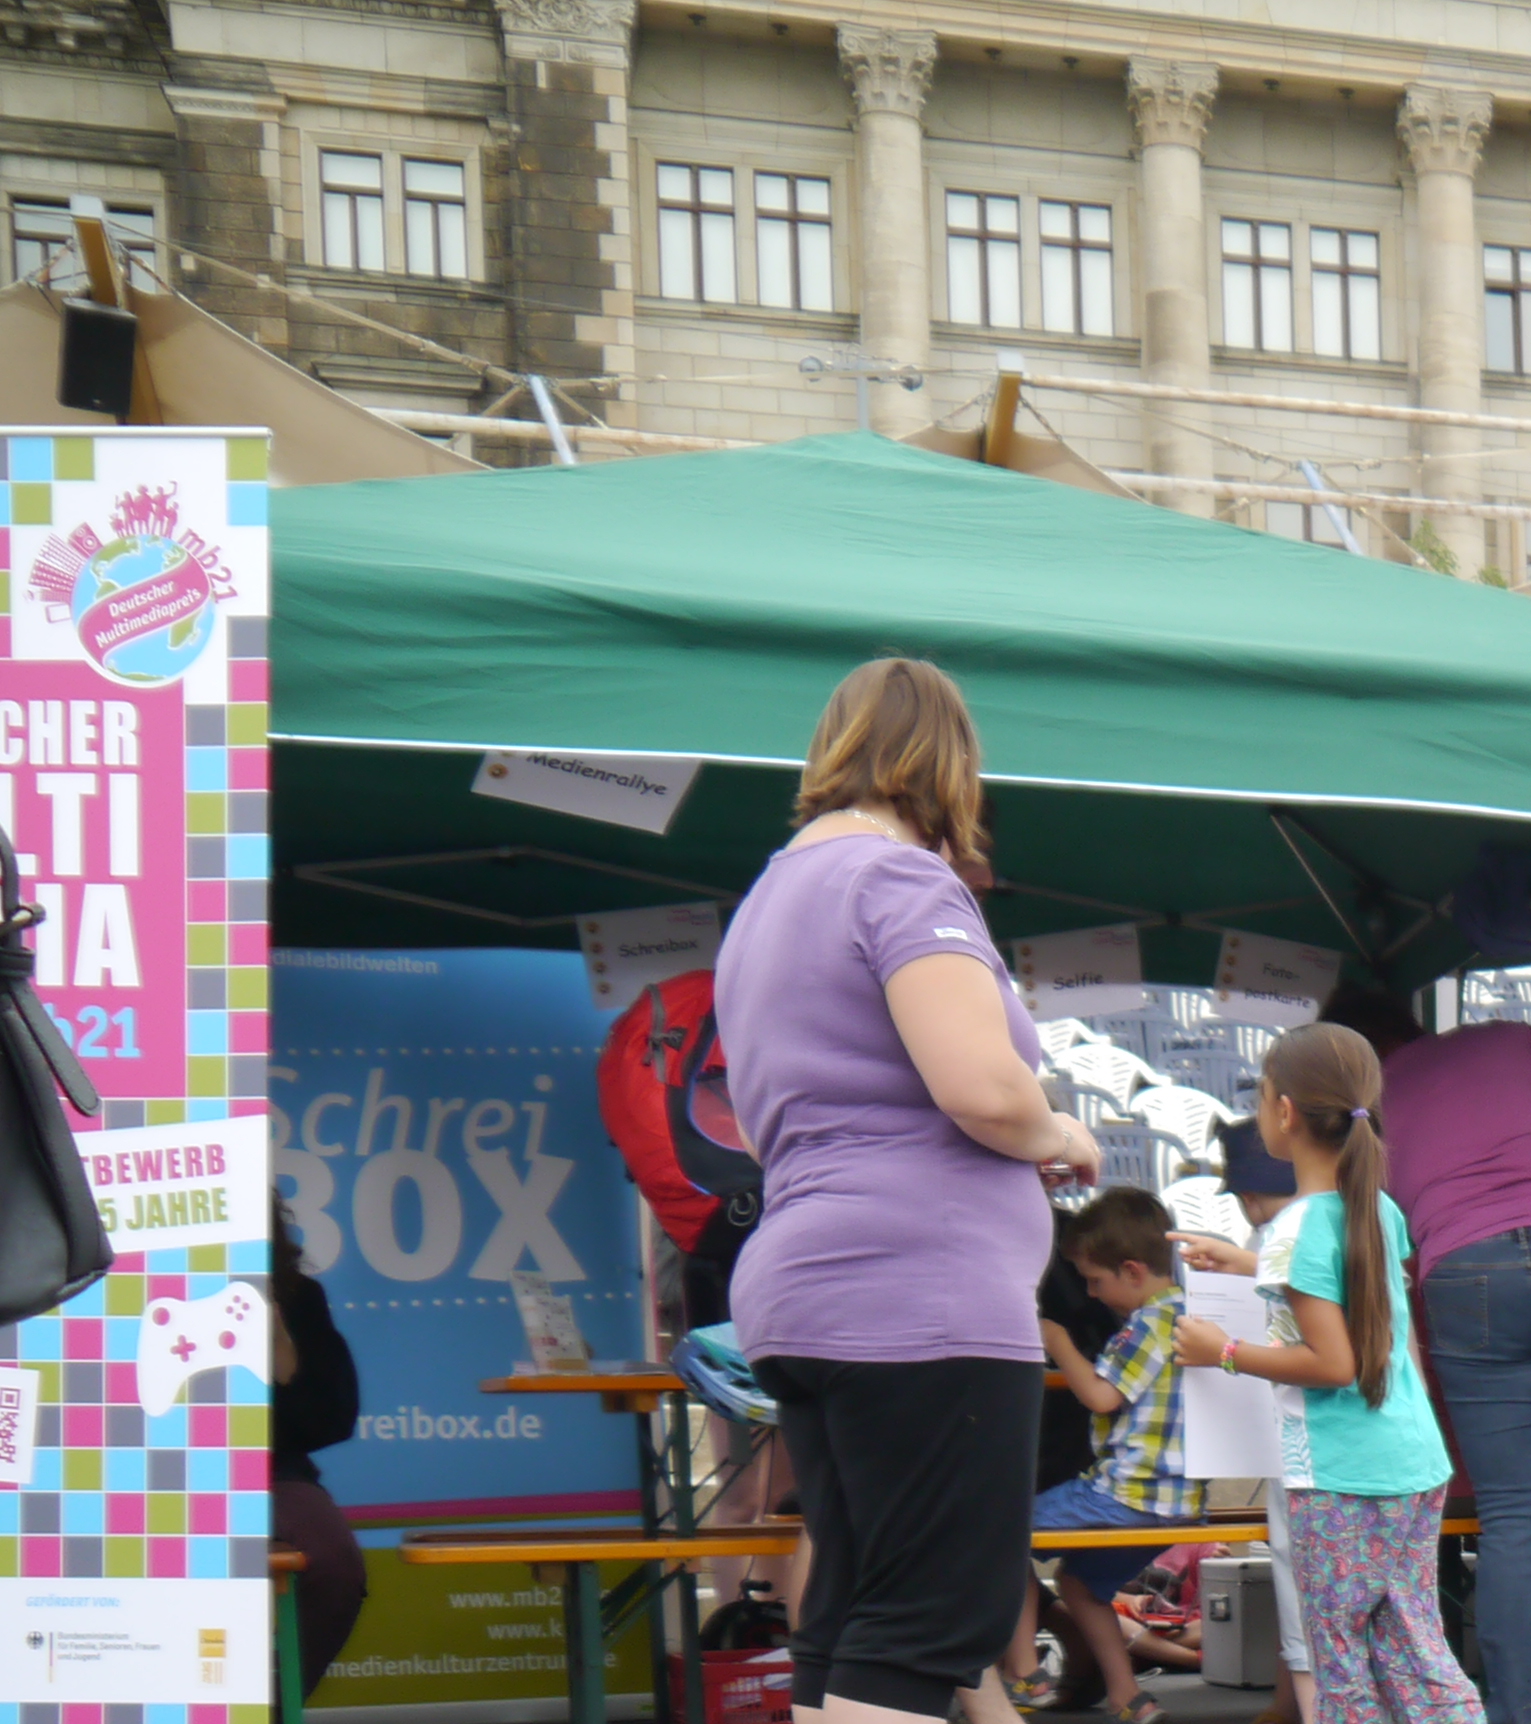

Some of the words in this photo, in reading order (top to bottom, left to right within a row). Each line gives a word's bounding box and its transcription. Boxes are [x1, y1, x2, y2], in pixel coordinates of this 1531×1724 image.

[178, 528, 238, 604] mb21
[95, 588, 202, 648] Multimediapreis
[108, 580, 175, 618] Deutscher
[526, 752, 668, 795] Medienrallye
[1053, 972, 1105, 990] Selfie
[80, 1143, 226, 1187] BEWERB
[125, 1187, 229, 1231] JAHRE
